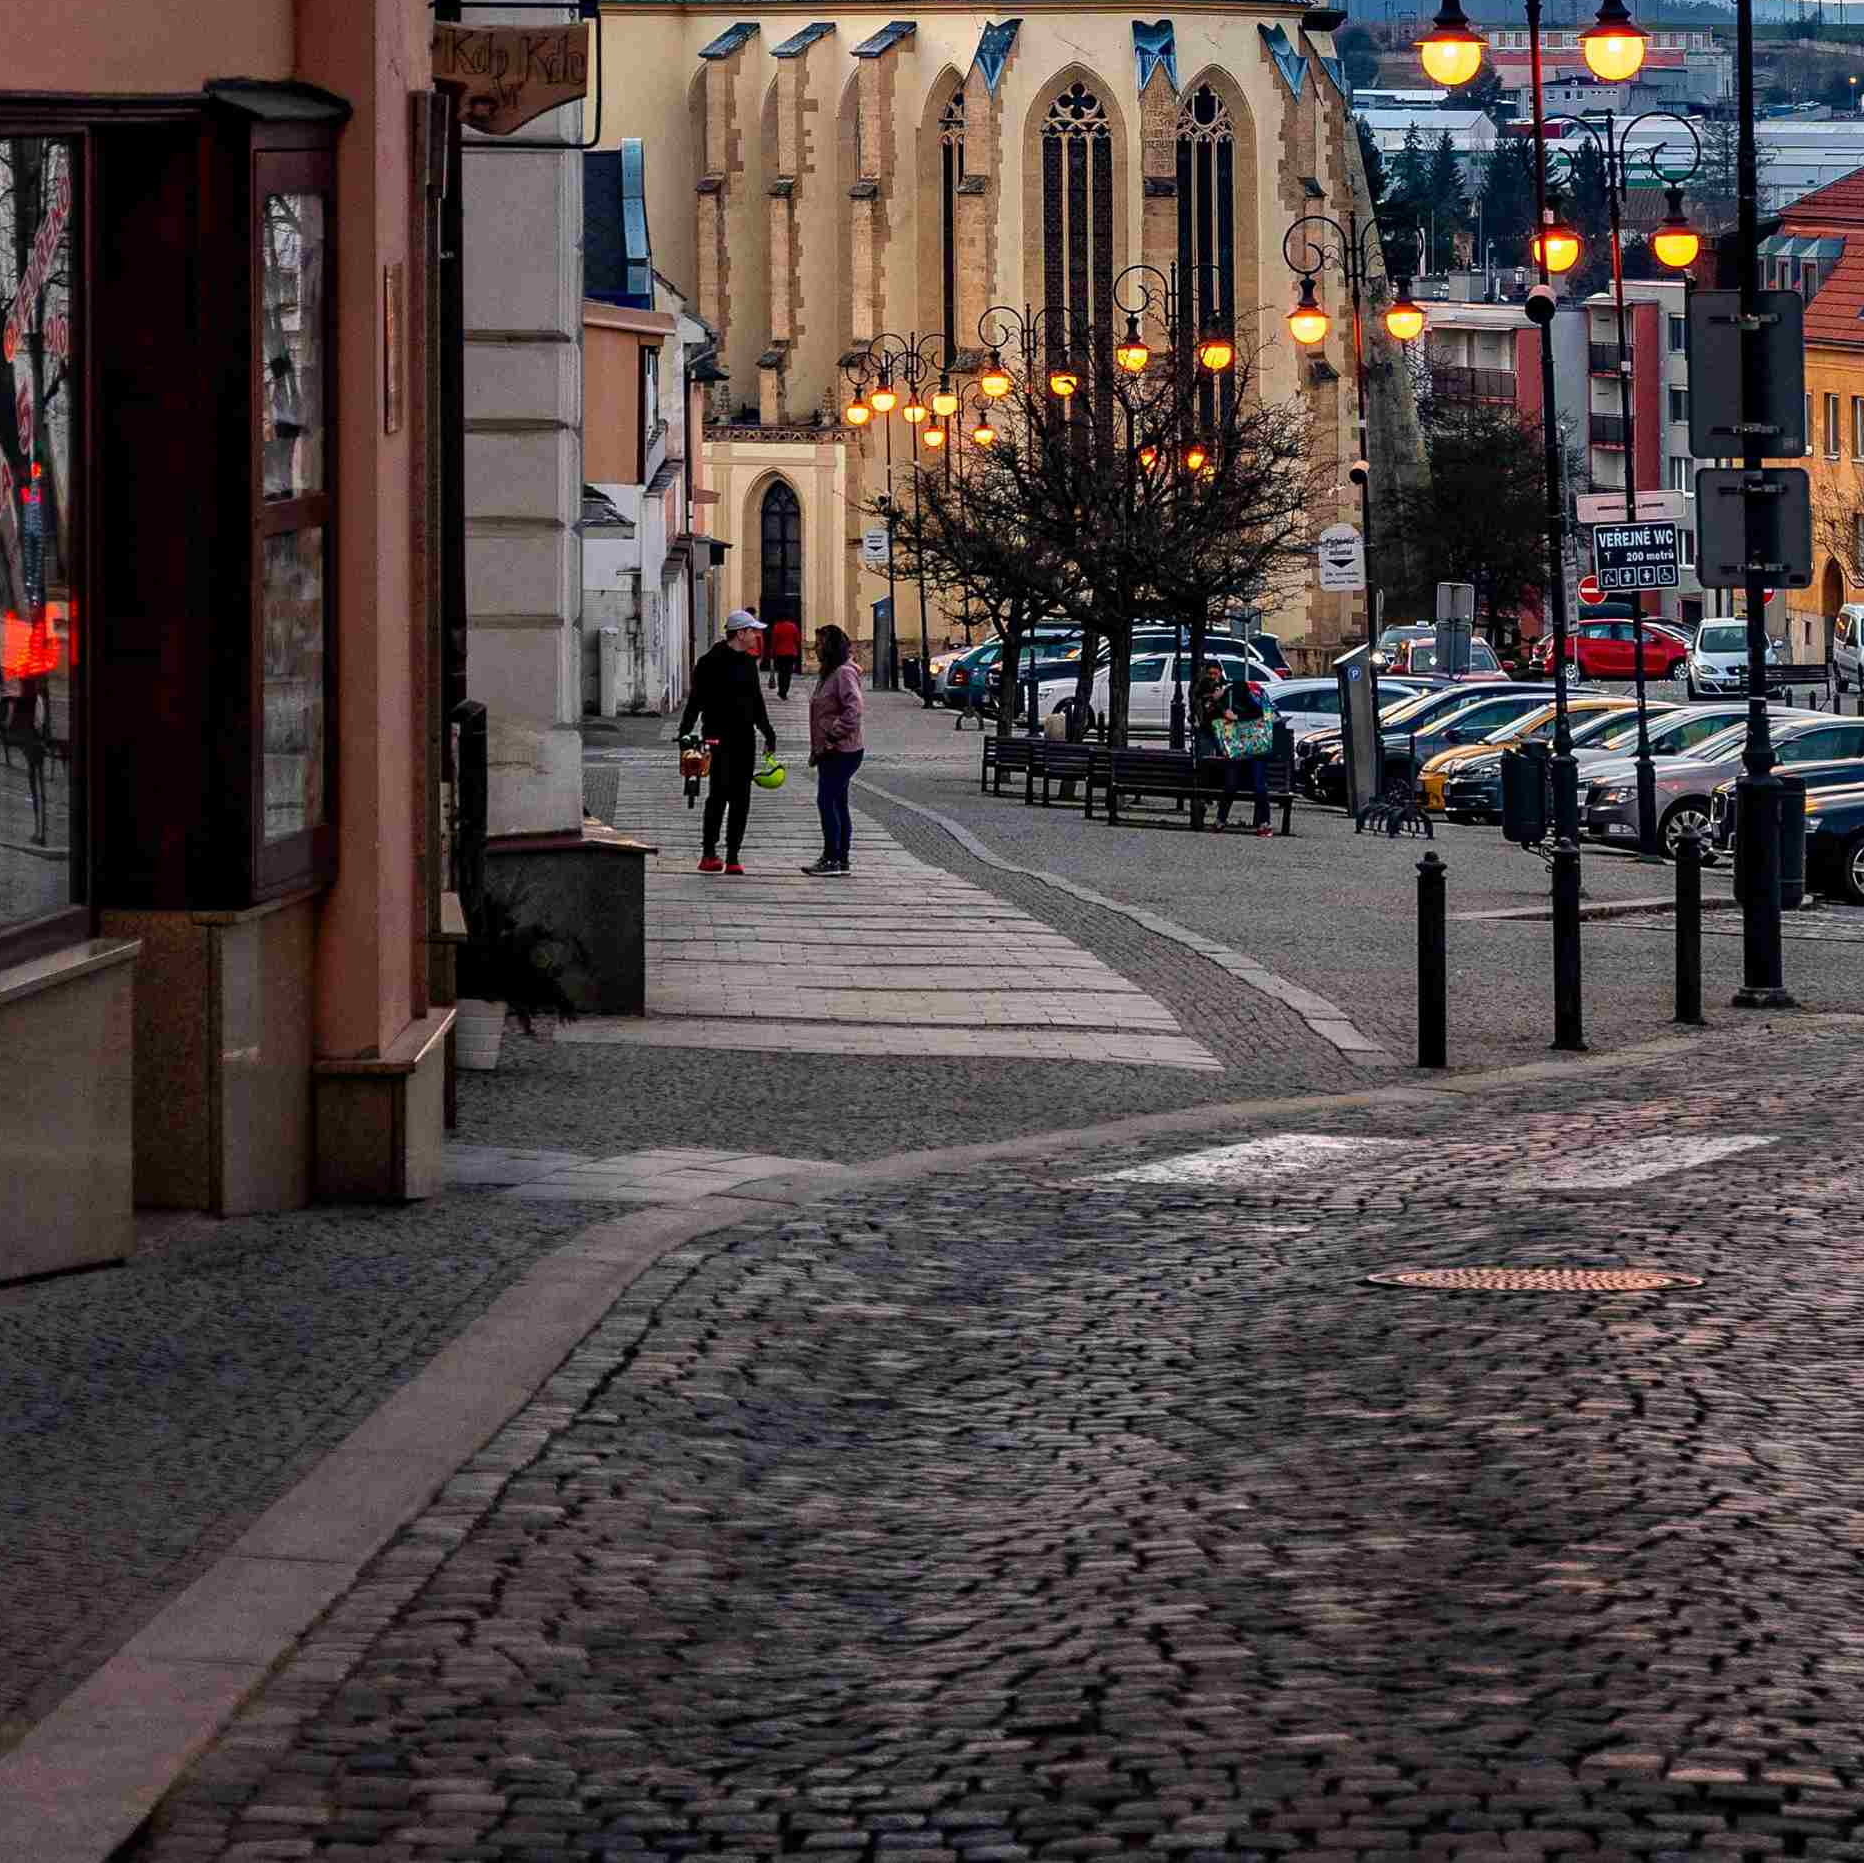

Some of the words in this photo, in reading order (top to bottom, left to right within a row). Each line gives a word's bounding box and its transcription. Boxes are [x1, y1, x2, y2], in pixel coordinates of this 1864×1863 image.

[1598, 526, 1652, 548] VEŘEJNÉ
[1653, 528, 1674, 545] WC
[1626, 551, 1645, 562] 200
